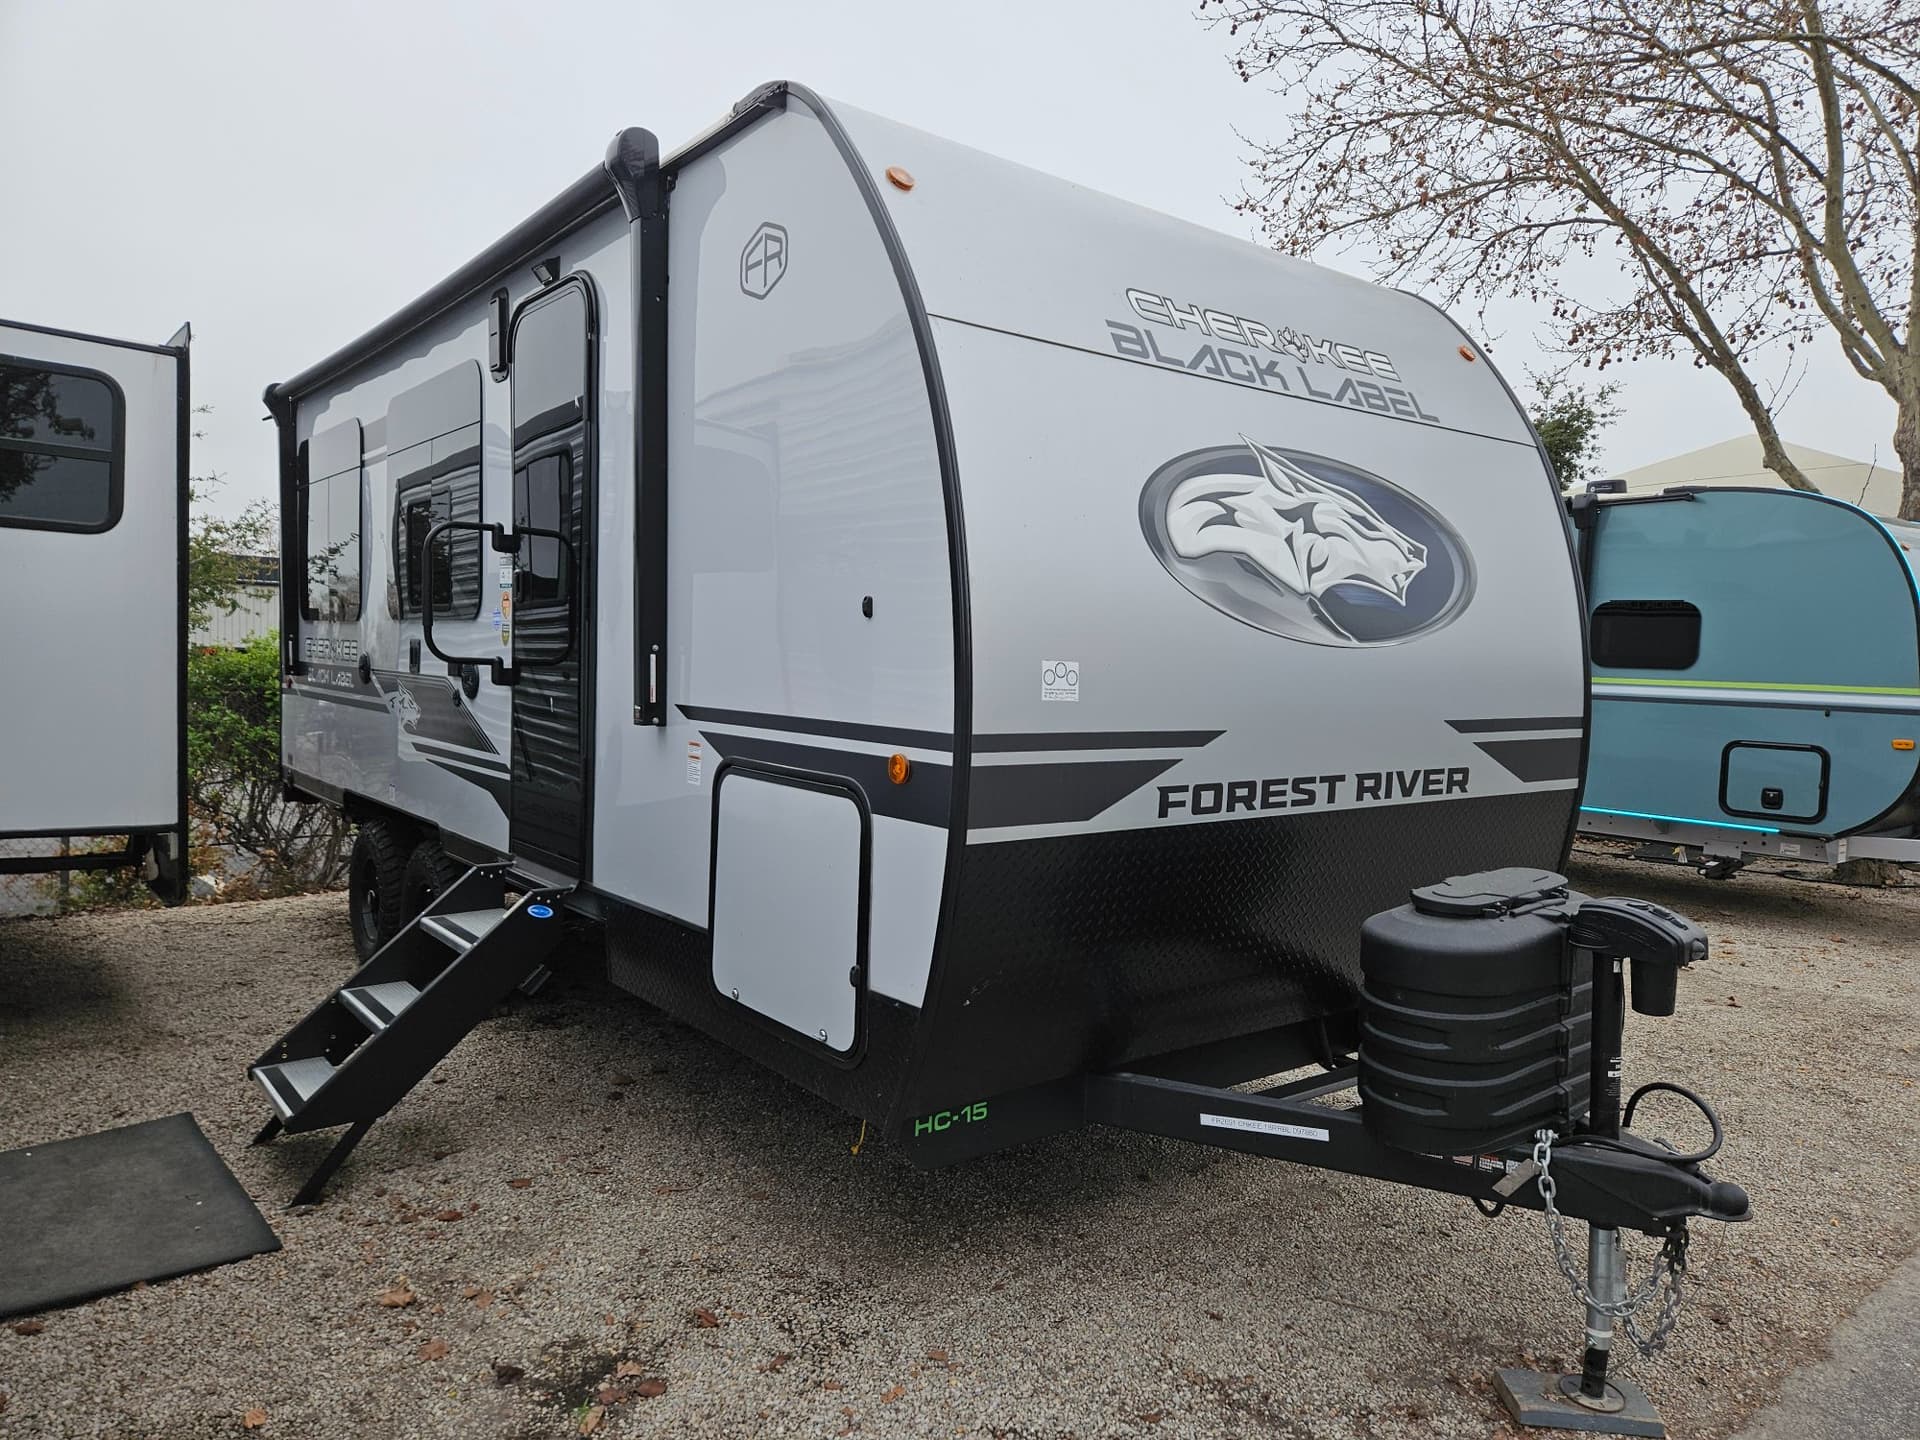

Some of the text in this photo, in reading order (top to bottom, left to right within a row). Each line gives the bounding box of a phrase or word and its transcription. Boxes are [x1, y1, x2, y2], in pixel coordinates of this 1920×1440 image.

[1105, 319, 1440, 423] BLACK LABEL
[1157, 767, 1470, 819] FOREST RIVER
[914, 1101, 988, 1137] HC-15
